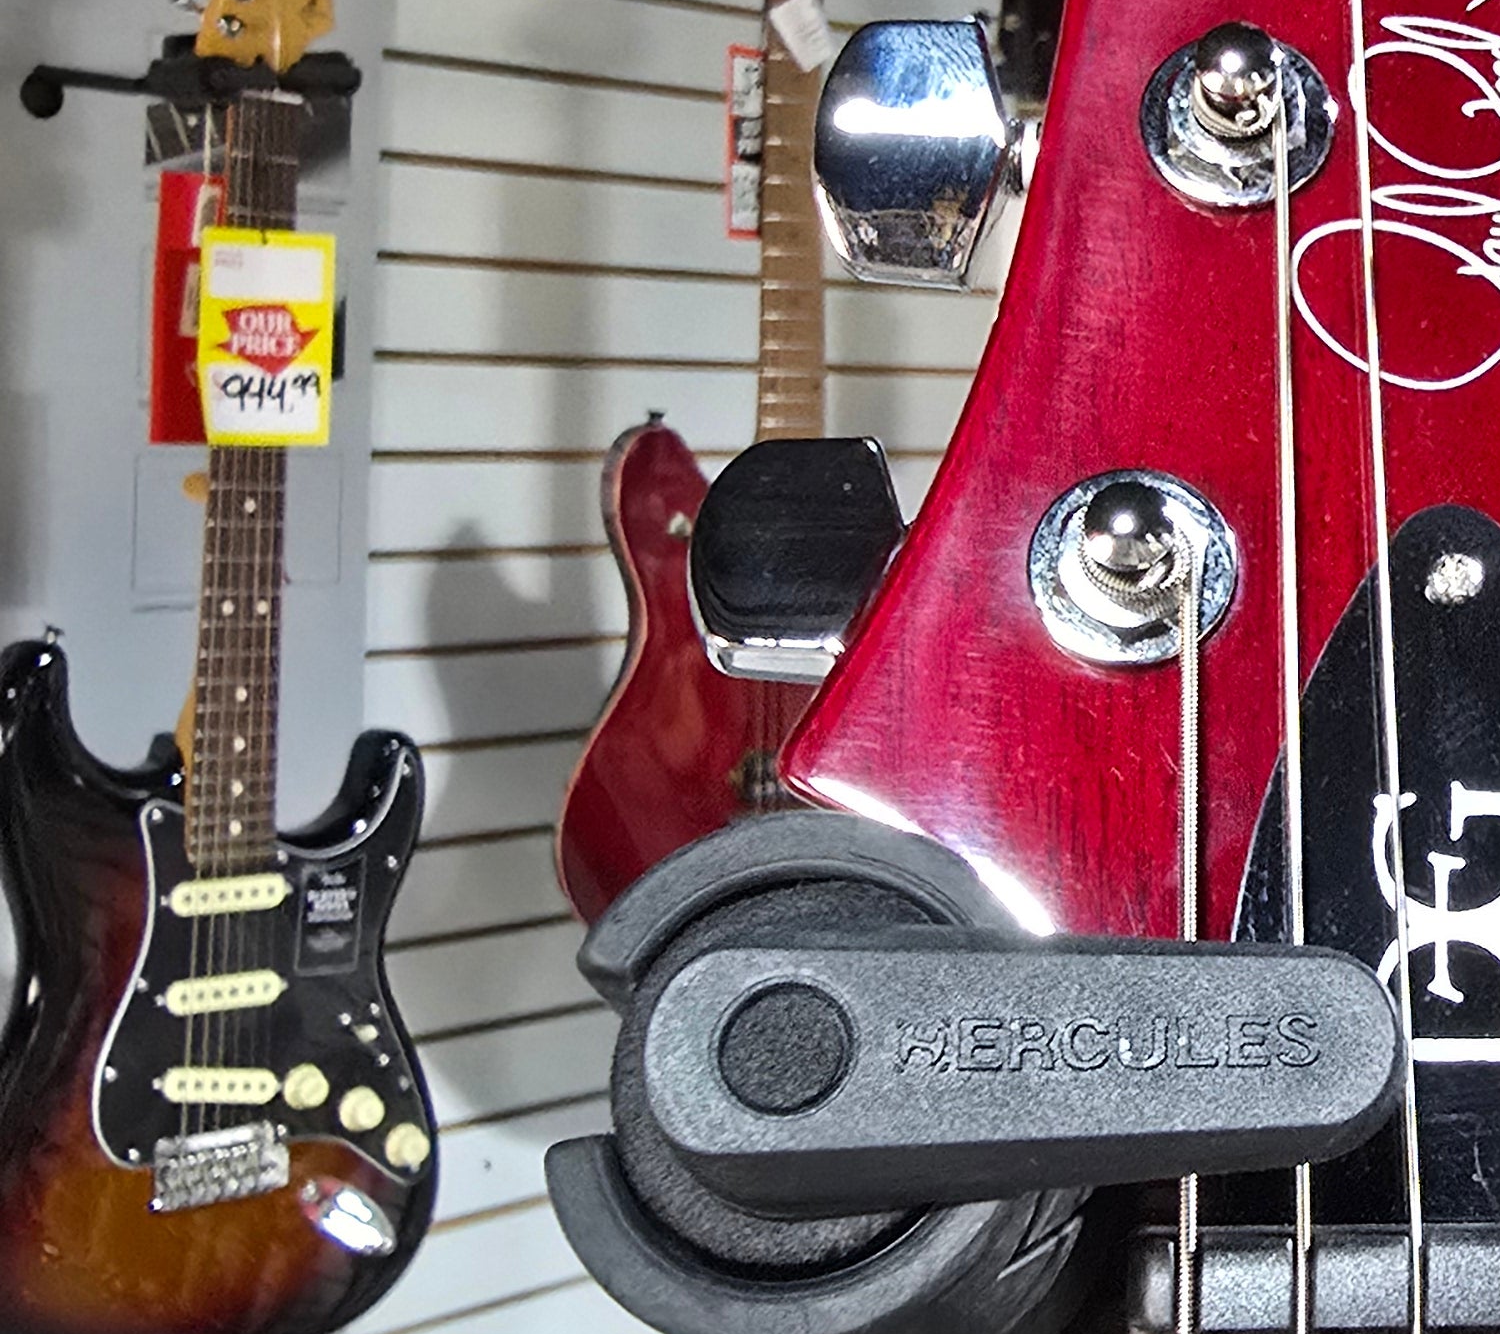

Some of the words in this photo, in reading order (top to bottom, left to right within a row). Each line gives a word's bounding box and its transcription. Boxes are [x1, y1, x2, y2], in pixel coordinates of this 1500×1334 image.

[238, 310, 293, 334] OUR
[231, 333, 298, 356] PRICE
[896, 1013, 1322, 1073] HERCULES
